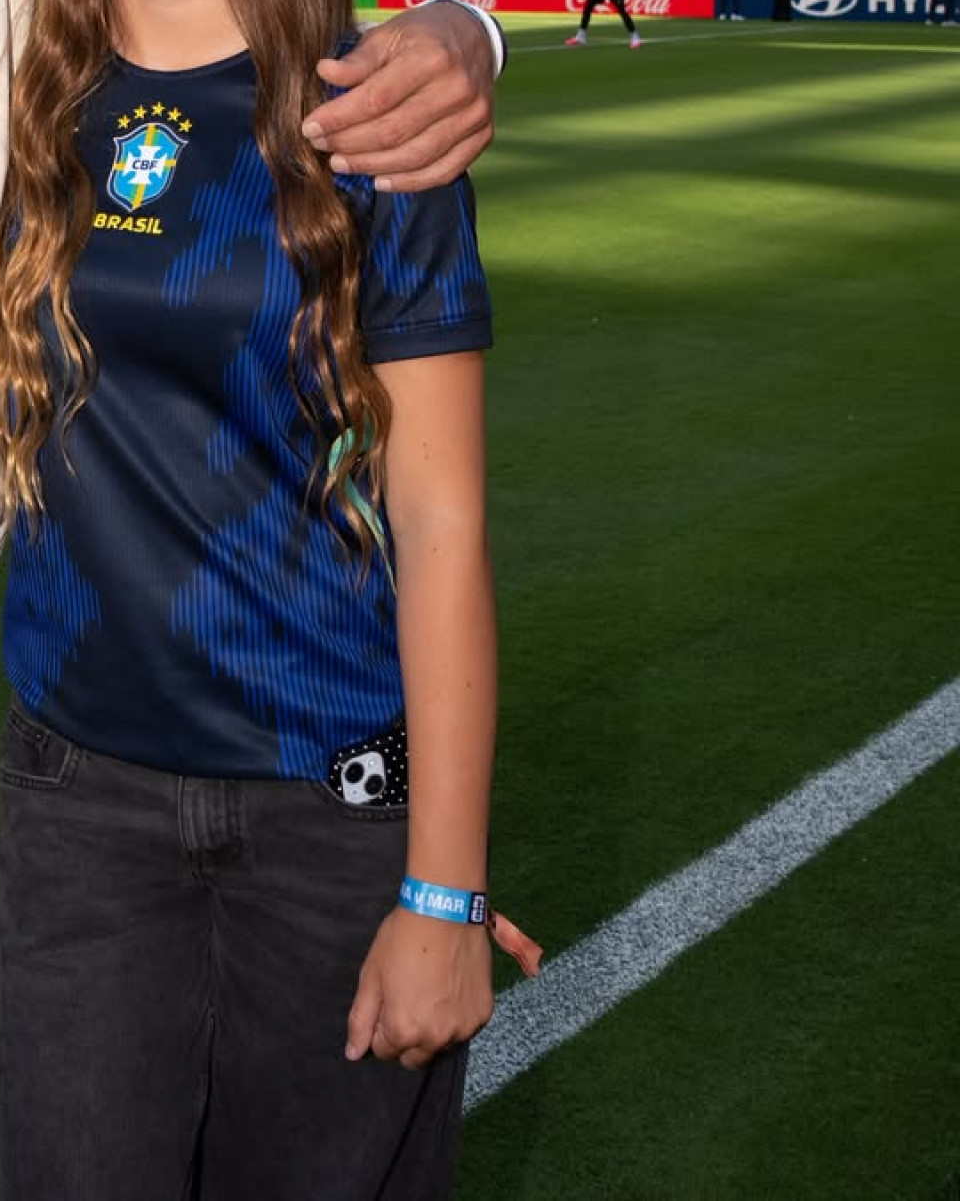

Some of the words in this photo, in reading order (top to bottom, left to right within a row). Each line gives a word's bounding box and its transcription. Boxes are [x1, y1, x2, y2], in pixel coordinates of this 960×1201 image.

[132, 160, 158, 170] CBF
[93, 213, 163, 234] BRASIL
[427, 893, 465, 914] MAR
